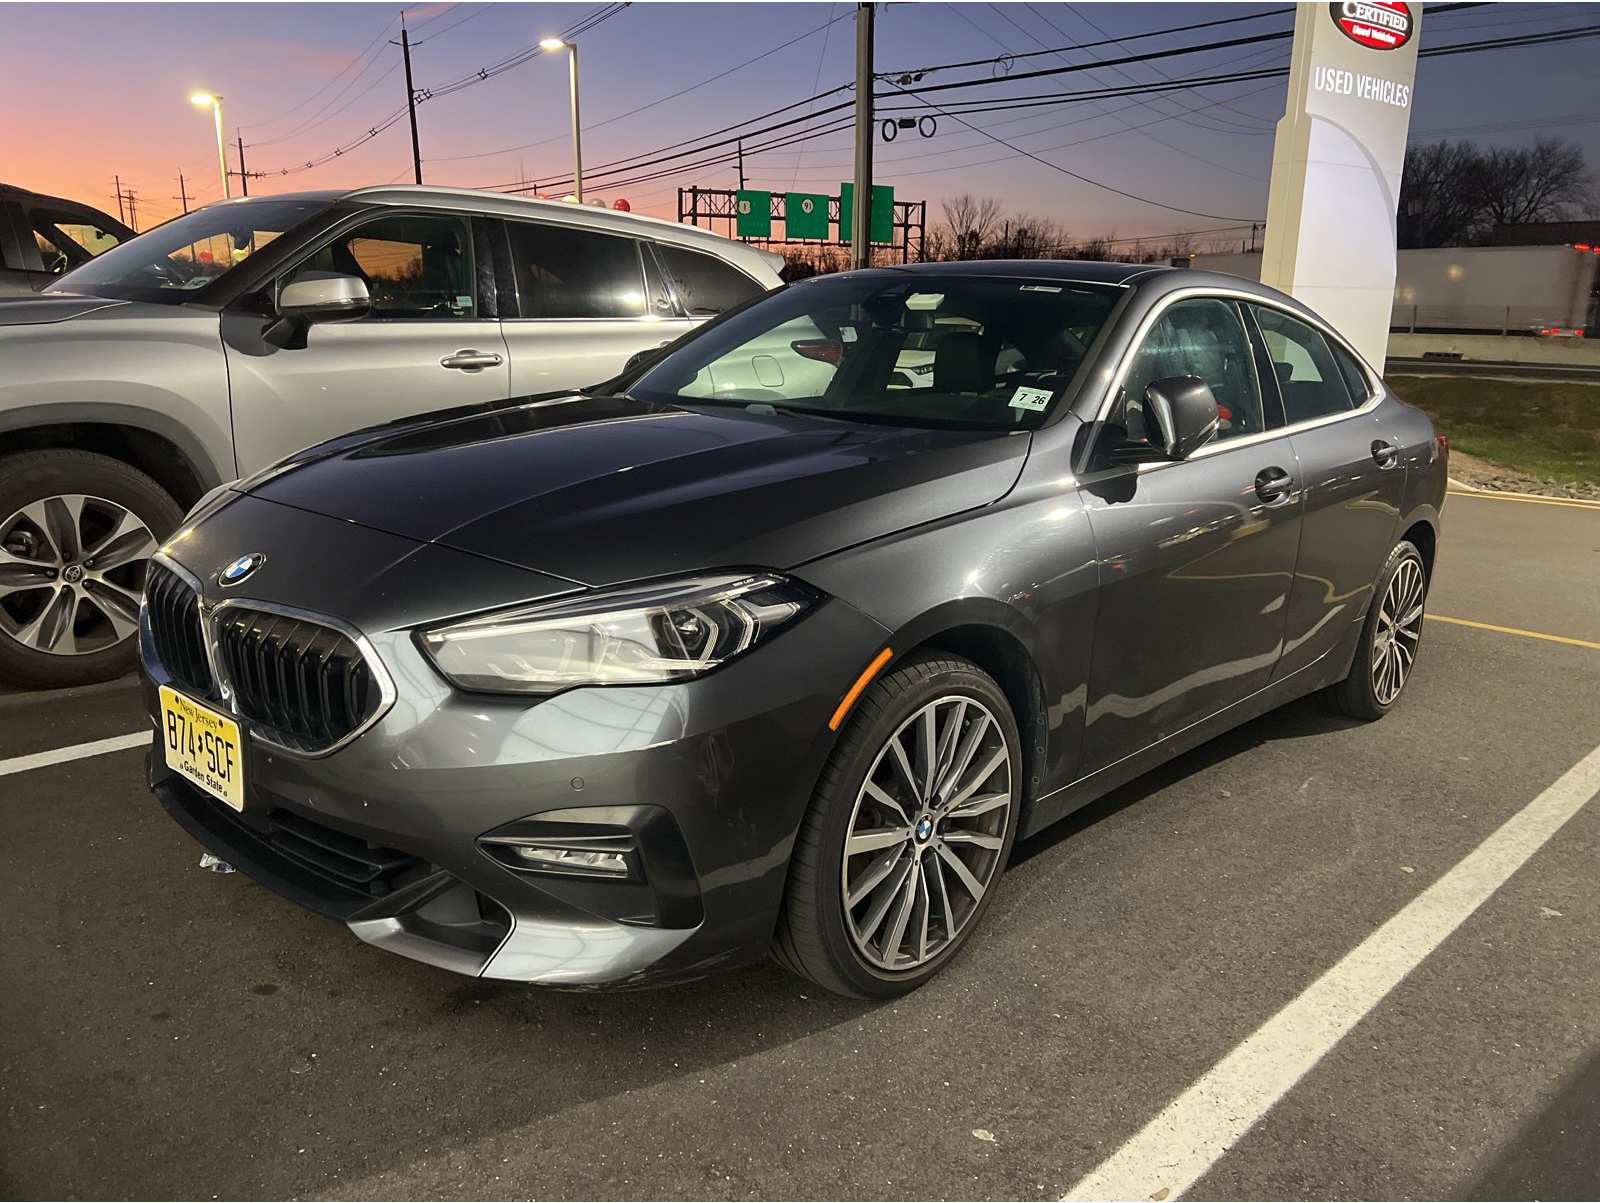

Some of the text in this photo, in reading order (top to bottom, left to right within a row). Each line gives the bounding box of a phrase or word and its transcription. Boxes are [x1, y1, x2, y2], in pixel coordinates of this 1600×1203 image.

[1342, 2, 1408, 31] CERTIFIED
[1314, 66, 1410, 108] USED VEHICLES
[1019, 393, 1046, 405] 7 26
[180, 698, 218, 733] New Jersey
[184, 761, 224, 793] Garden State
